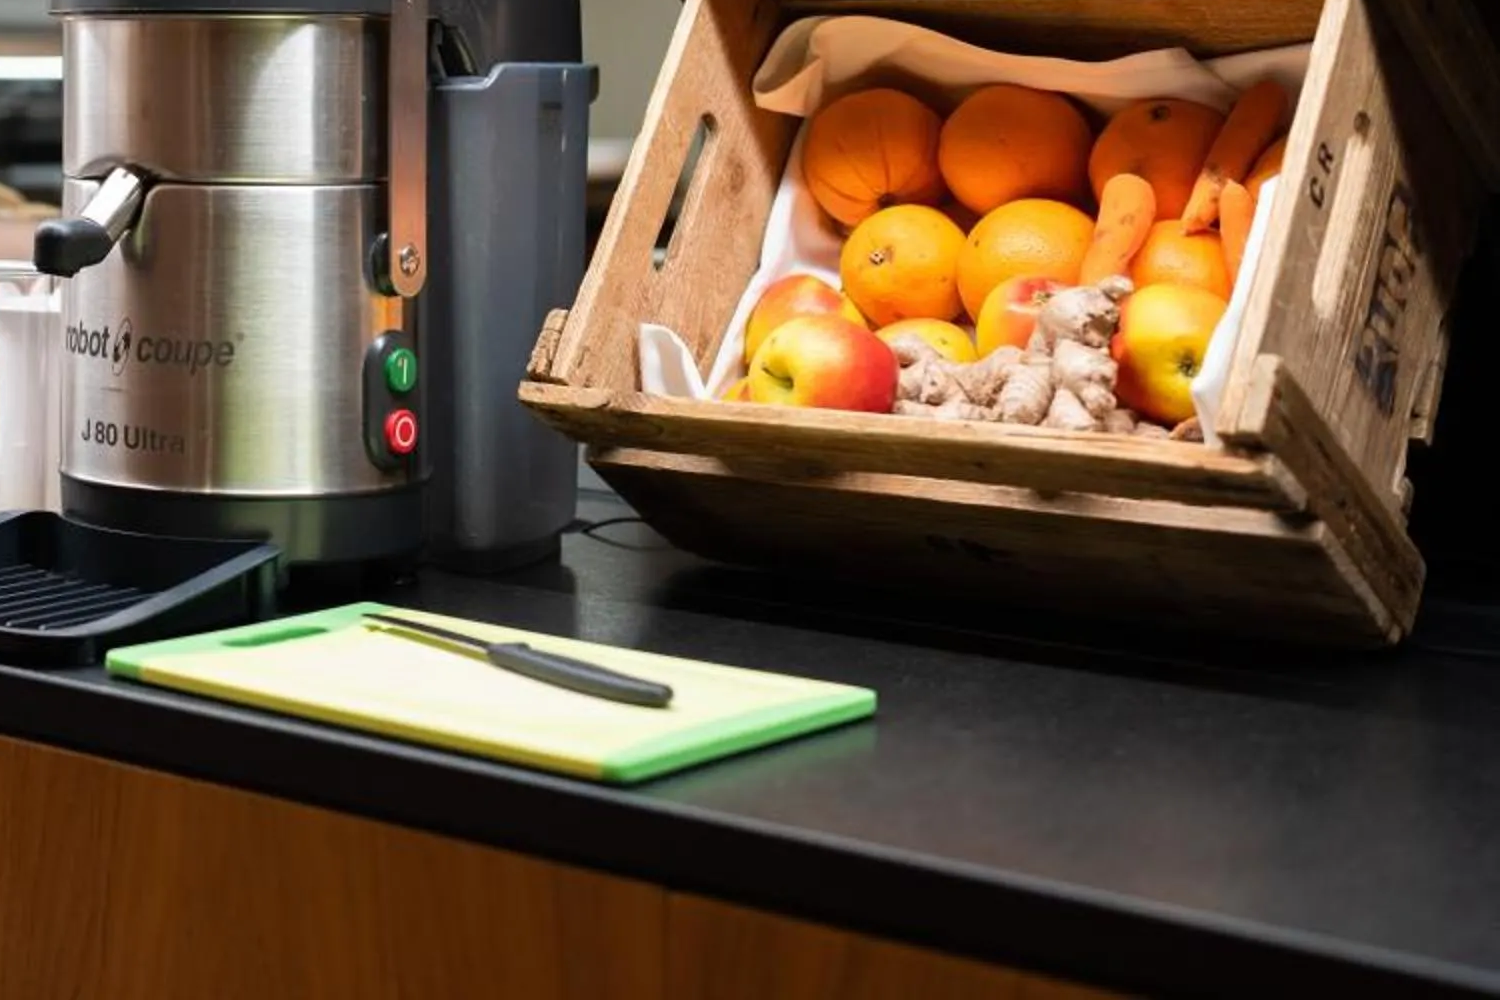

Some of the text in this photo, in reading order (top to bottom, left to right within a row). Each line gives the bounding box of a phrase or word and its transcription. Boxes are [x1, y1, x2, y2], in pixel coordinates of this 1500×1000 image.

[65, 320, 110, 359] robot
[81, 417, 186, 454] J 80 Ultra
